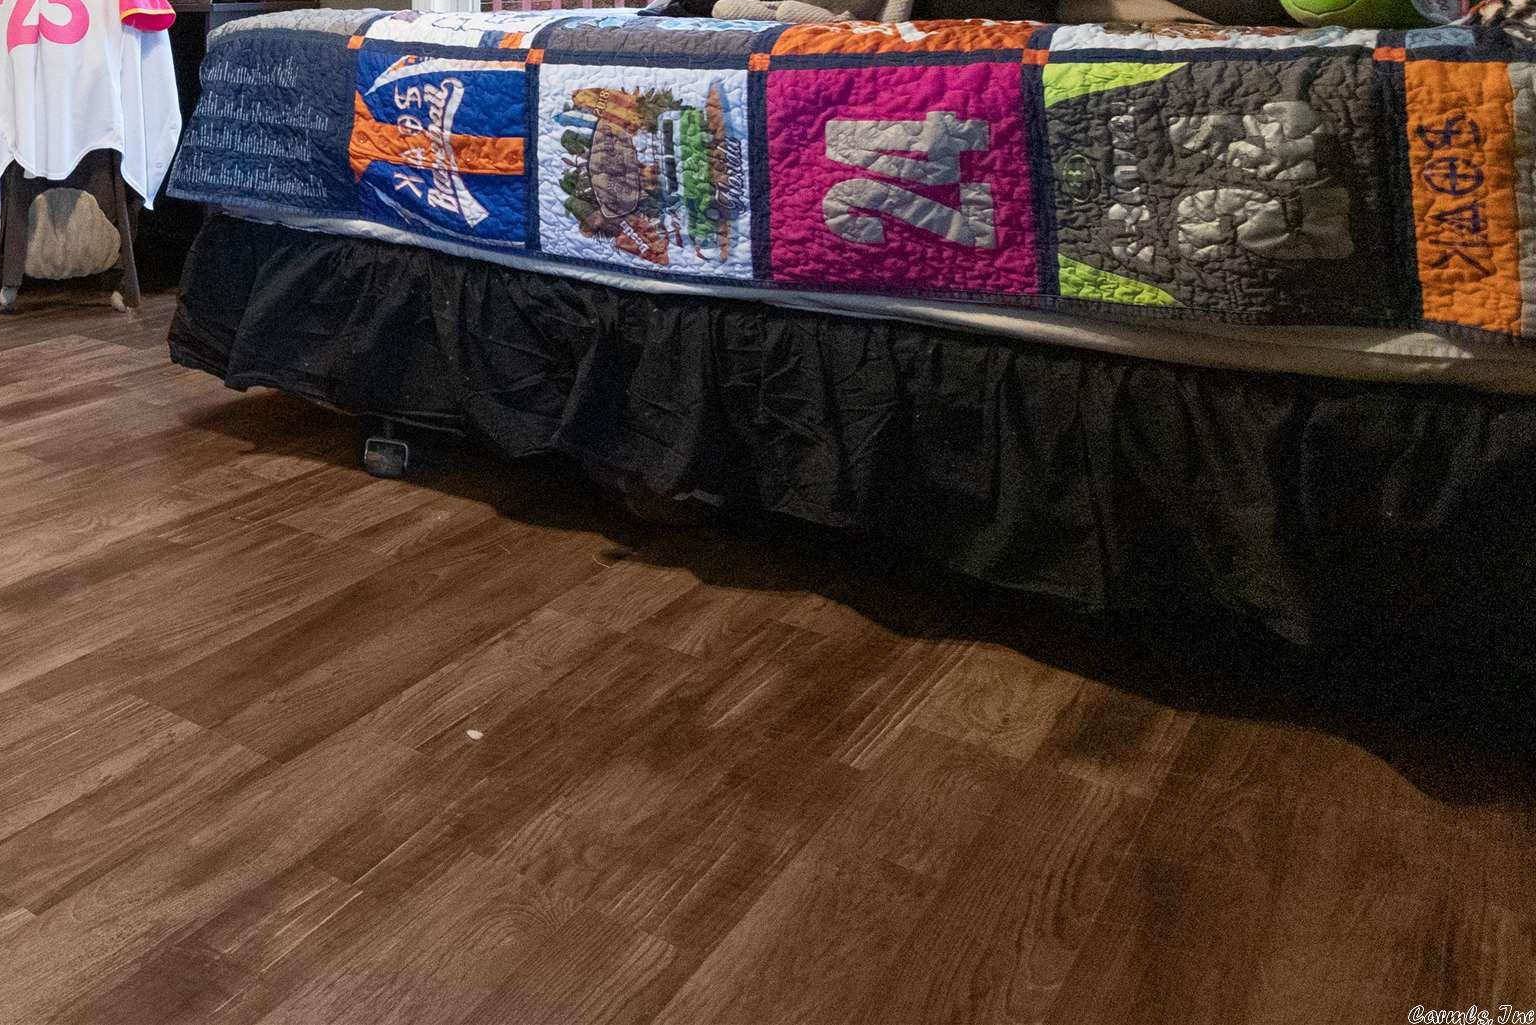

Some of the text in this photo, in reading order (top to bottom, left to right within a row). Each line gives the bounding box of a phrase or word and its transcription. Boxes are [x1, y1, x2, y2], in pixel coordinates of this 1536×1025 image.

[593, 89, 610, 116] 2018
[715, 136, 749, 214] Florida
[822, 111, 997, 249] 24
